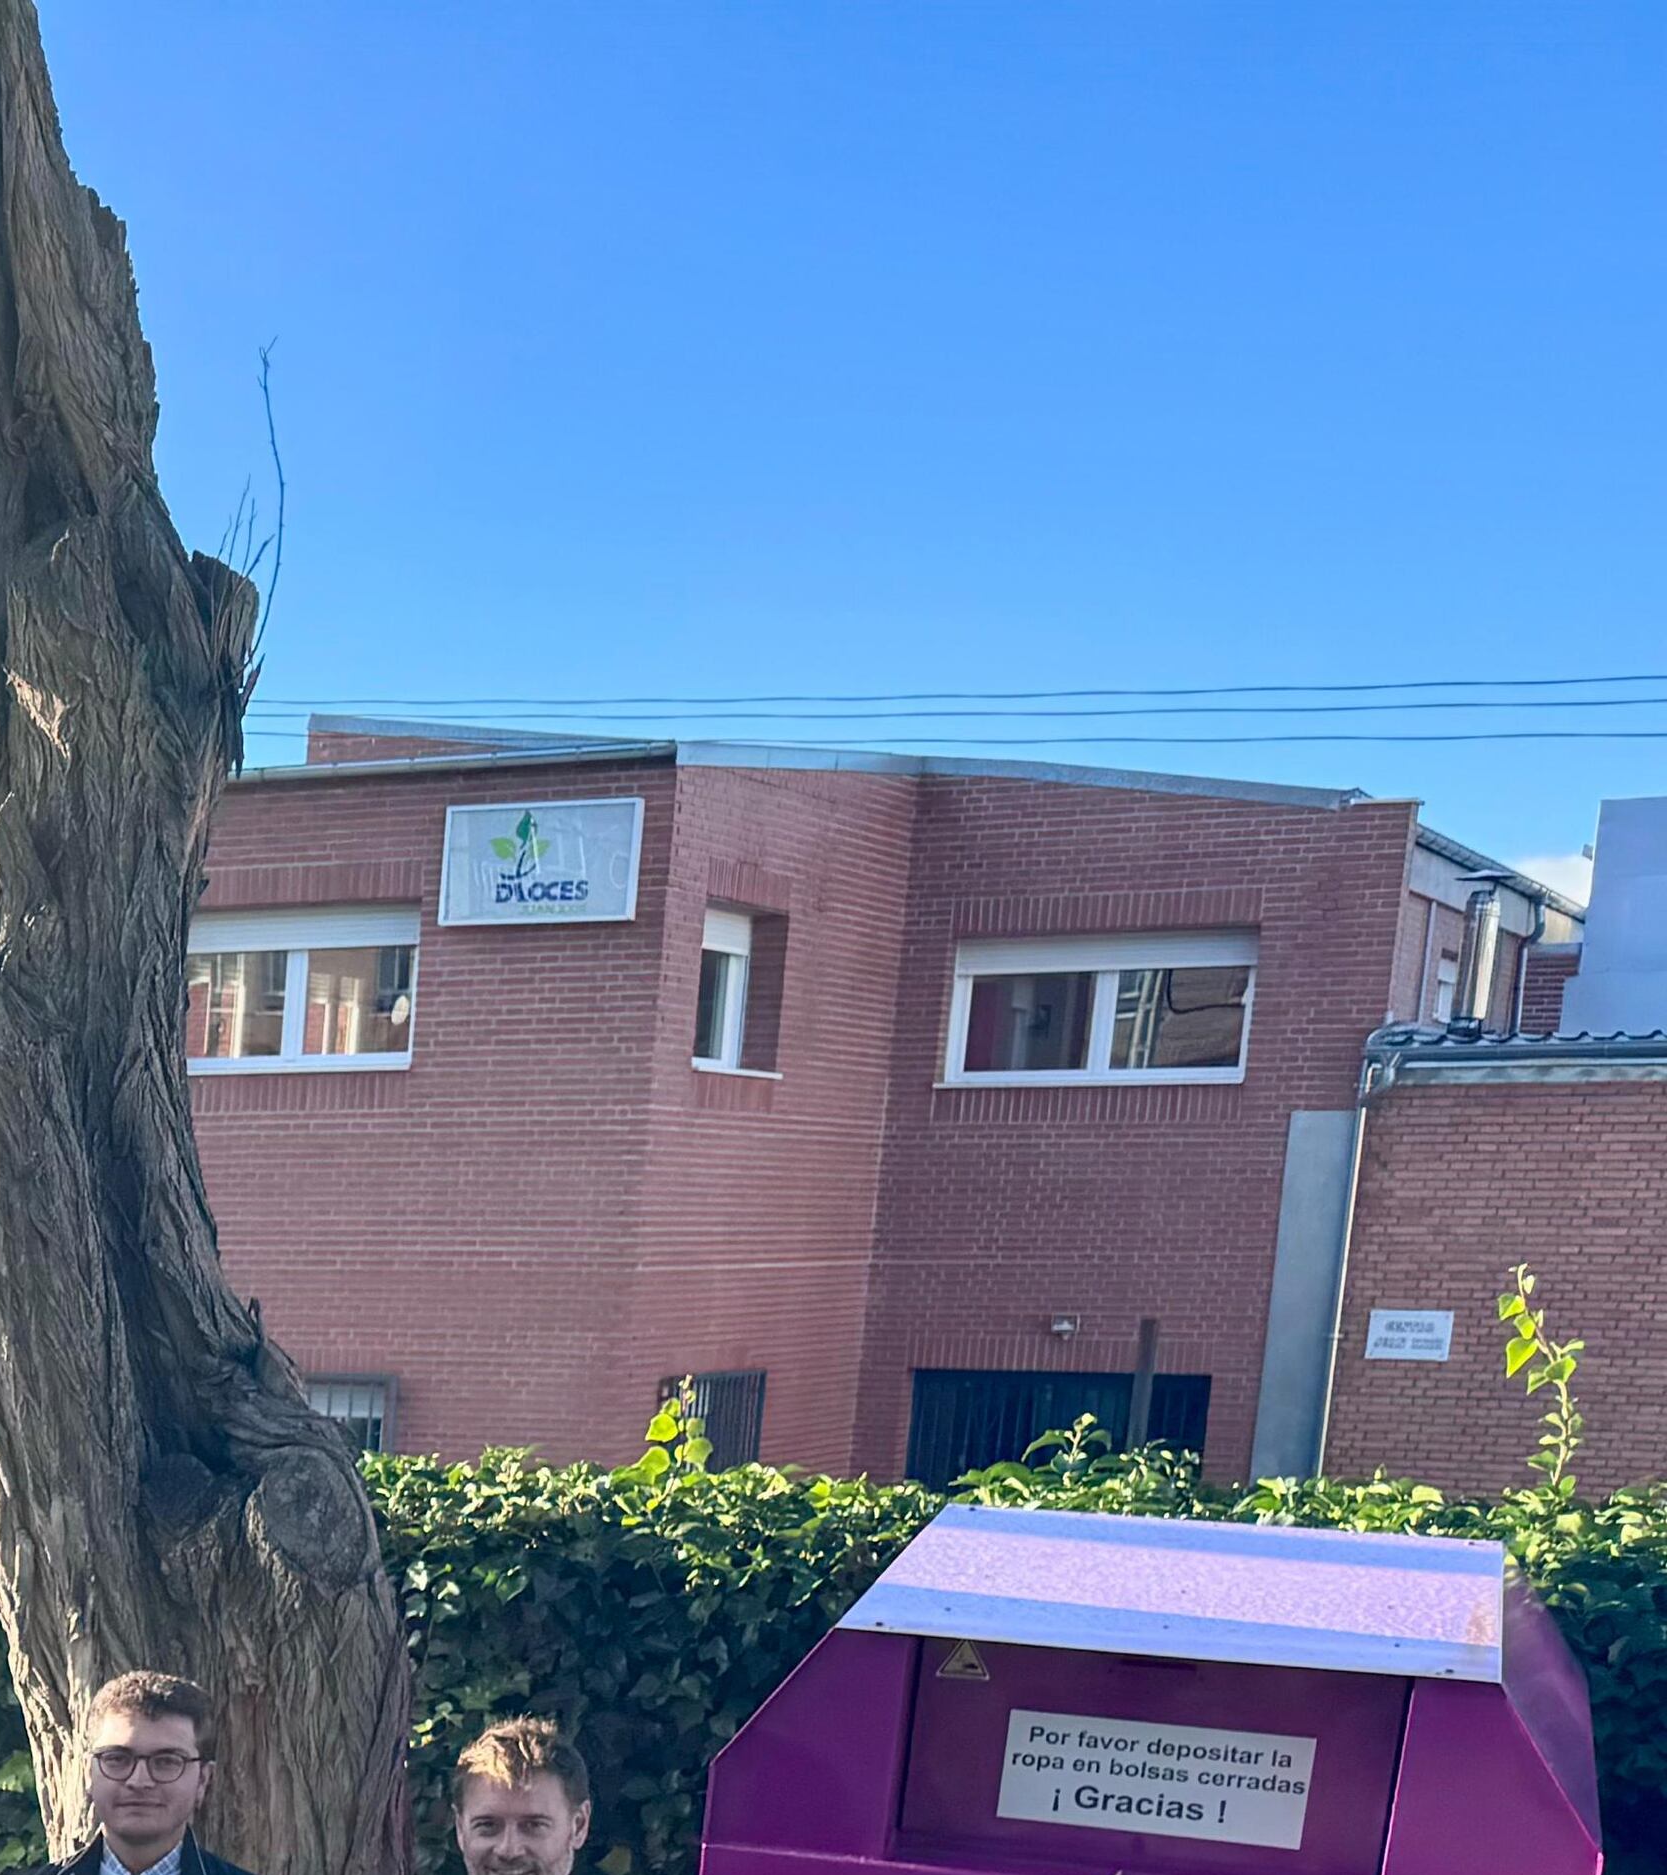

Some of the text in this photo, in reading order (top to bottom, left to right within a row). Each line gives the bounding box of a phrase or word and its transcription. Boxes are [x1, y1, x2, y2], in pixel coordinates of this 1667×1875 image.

[1028, 1725, 1293, 1769] Por favor depositar la
[1011, 1751, 1307, 1795] ropa en bolsas cerradas
[1074, 1785, 1205, 1822] Gracias
